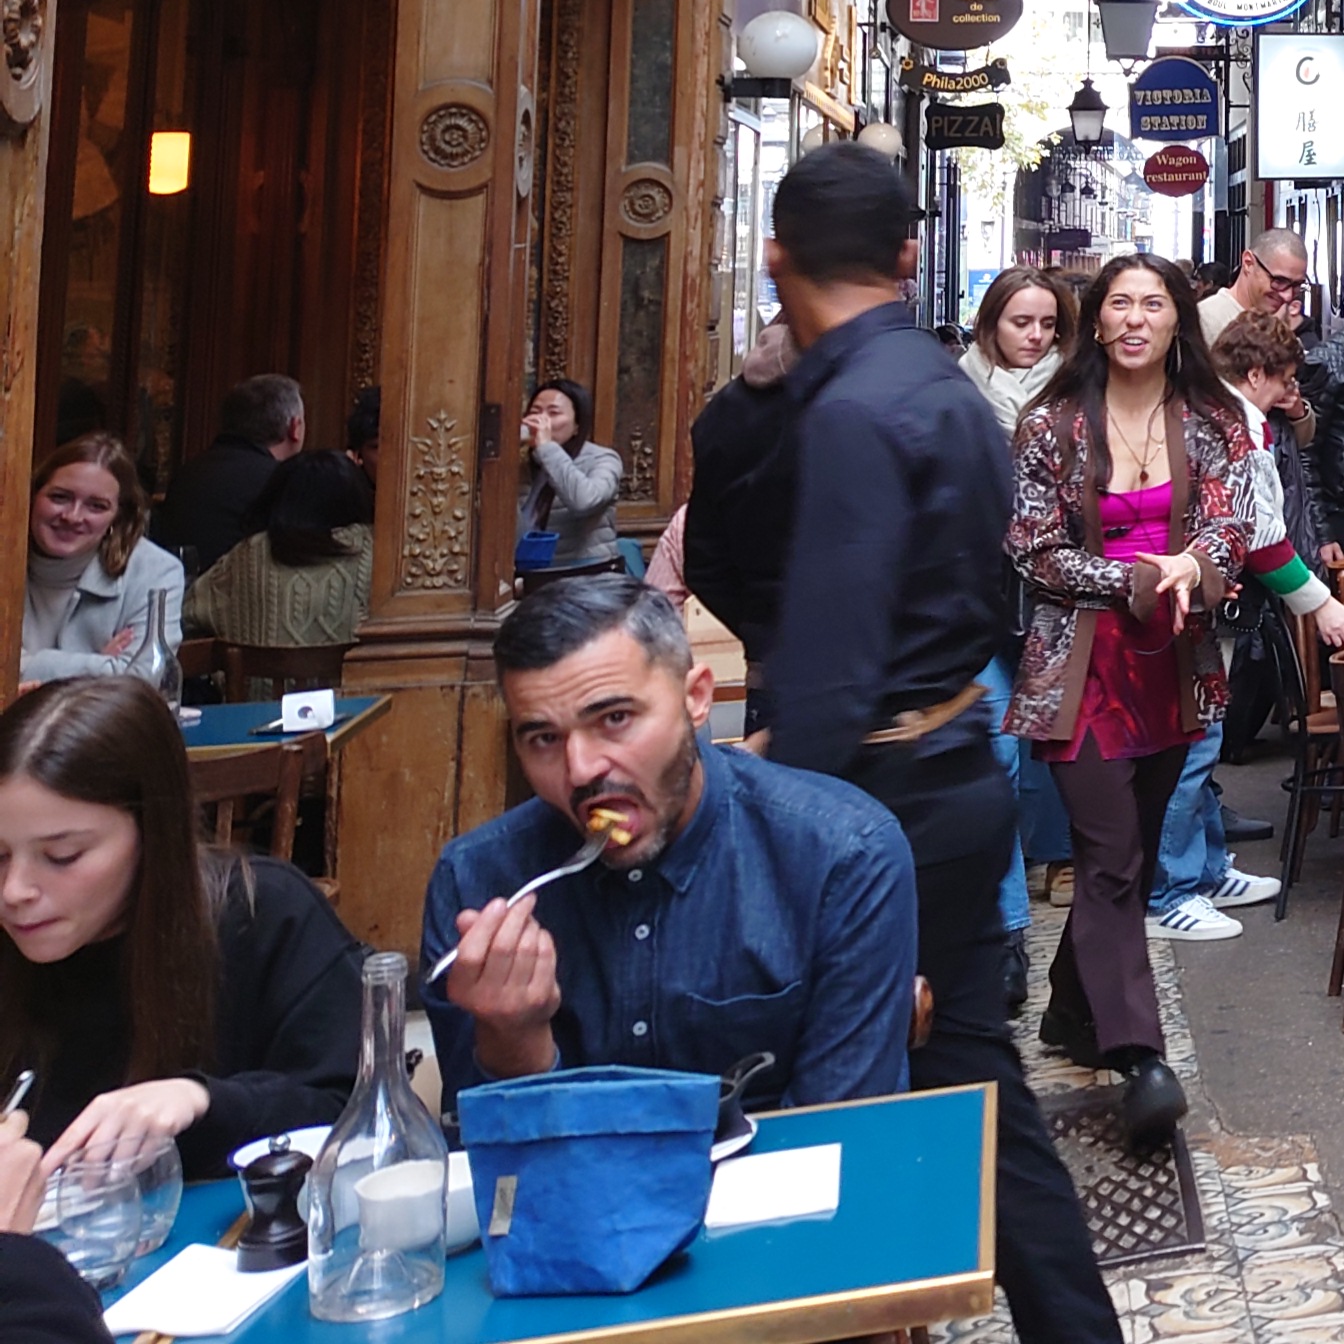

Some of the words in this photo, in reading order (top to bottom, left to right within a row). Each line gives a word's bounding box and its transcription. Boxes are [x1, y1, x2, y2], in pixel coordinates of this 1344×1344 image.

[970, 3, 983, 11] de
[952, 13, 1000, 23] collection
[922, 72, 989, 90] Phila2000
[1134, 88, 1212, 105] VICTORIA
[931, 113, 1000, 138] PIZZA!
[1140, 115, 1208, 131] STATION
[1155, 154, 1197, 167] Wagon
[1146, 171, 1207, 183] restaurant
